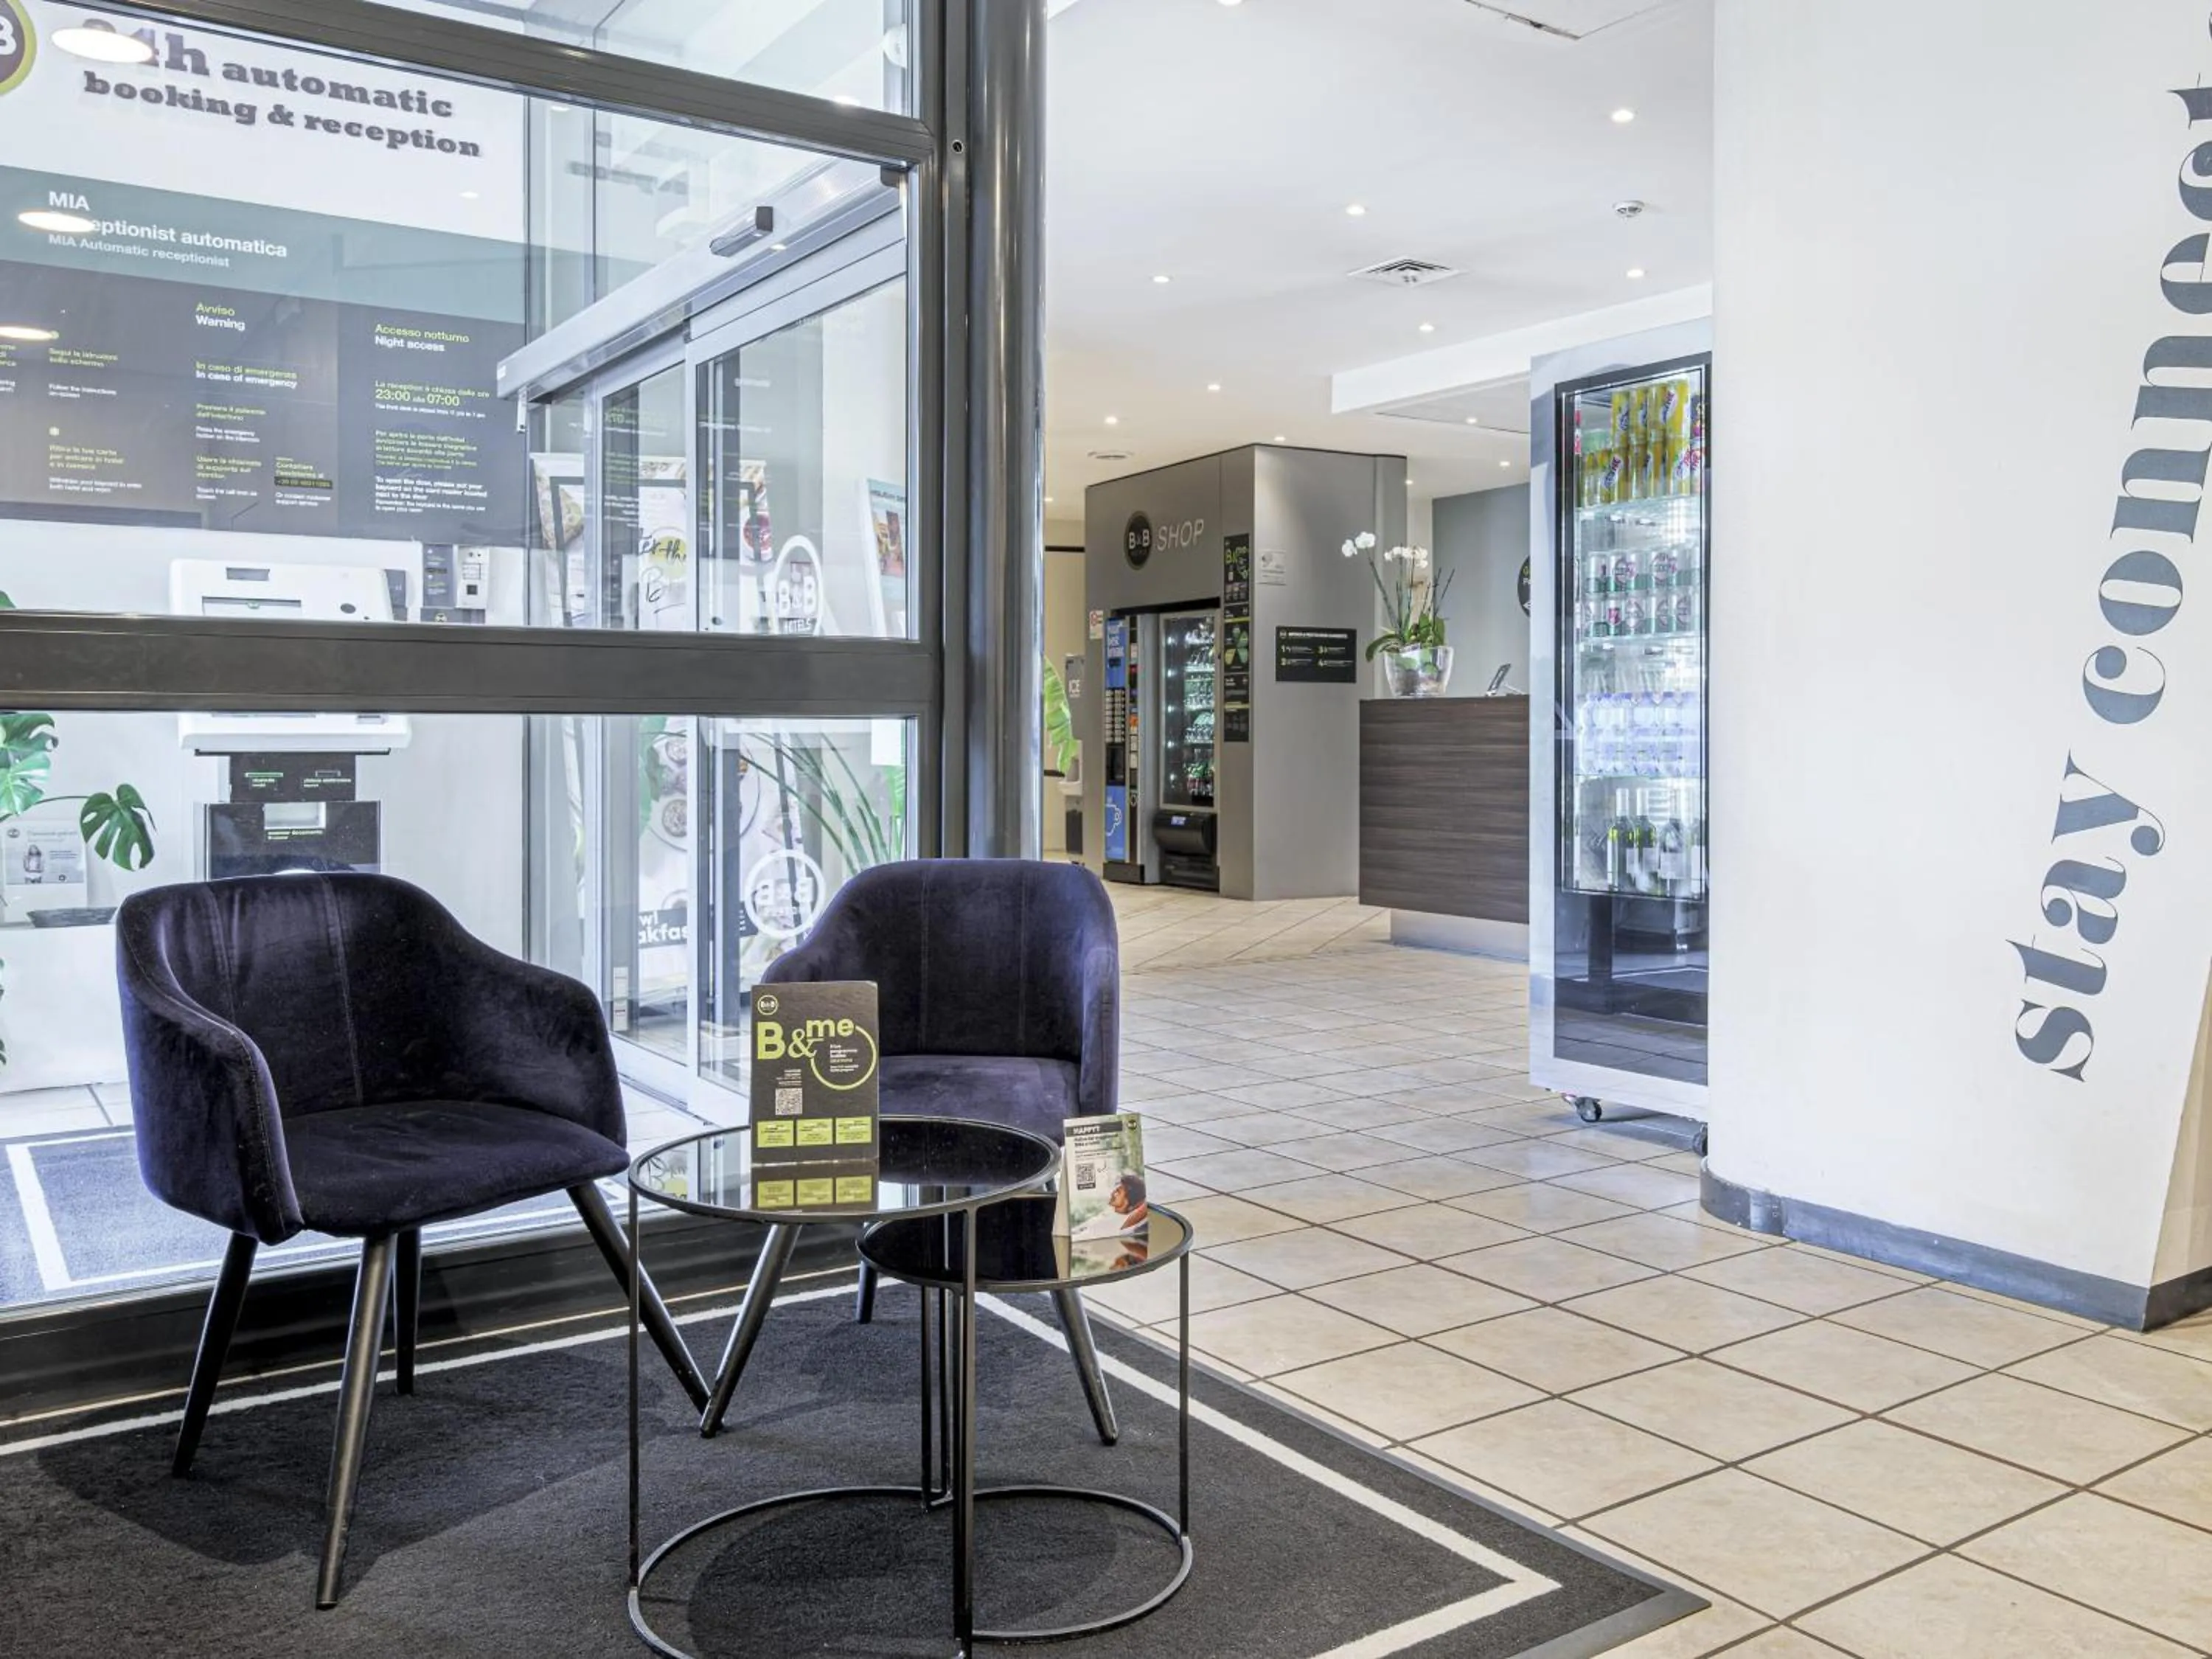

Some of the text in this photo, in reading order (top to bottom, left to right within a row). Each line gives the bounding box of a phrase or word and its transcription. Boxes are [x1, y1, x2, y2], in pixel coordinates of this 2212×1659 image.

[83, 18, 209, 76] 4h
[223, 62, 453, 117] automatic
[84, 71, 480, 157] booking & reception
[49, 191, 90, 211] MIA
[91, 218, 288, 257] eptionist automatica
[49, 234, 229, 267] MIA Automatic receptionist
[196, 302, 235, 316] Avviso
[195, 315, 246, 331] Warning
[375, 324, 470, 343] Accesso notturno
[375, 335, 445, 352] Night access
[245, 377, 297, 389] emergency
[375, 389, 410, 402] 23:00
[427, 394, 460, 406] 07:00
[1157, 518, 1204, 552] SHOP
[2006, 11, 2212, 1082] stay conne
[639, 909, 658, 925] wl
